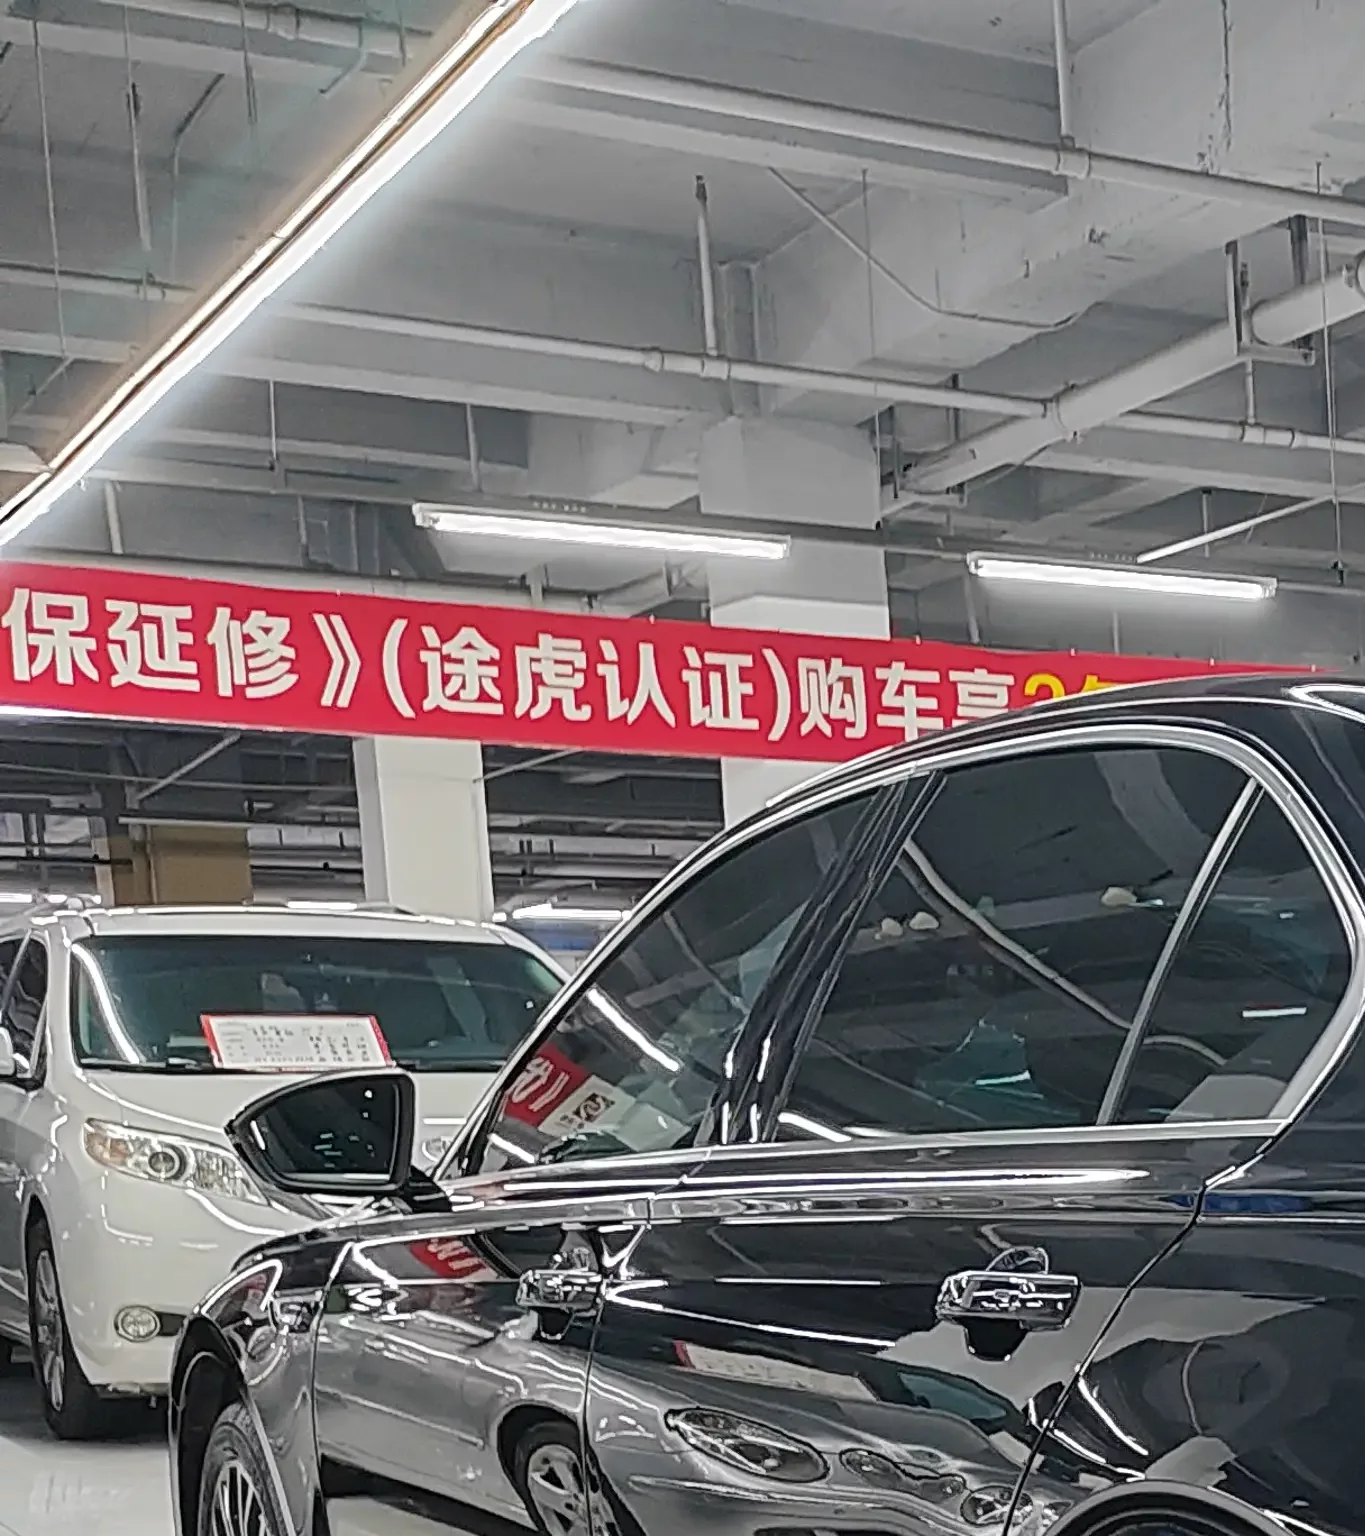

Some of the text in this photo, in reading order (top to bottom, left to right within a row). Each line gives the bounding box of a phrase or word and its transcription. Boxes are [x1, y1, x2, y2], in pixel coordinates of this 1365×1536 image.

[1, 587, 1130, 741] 保延修》(途虎认证)购车享
